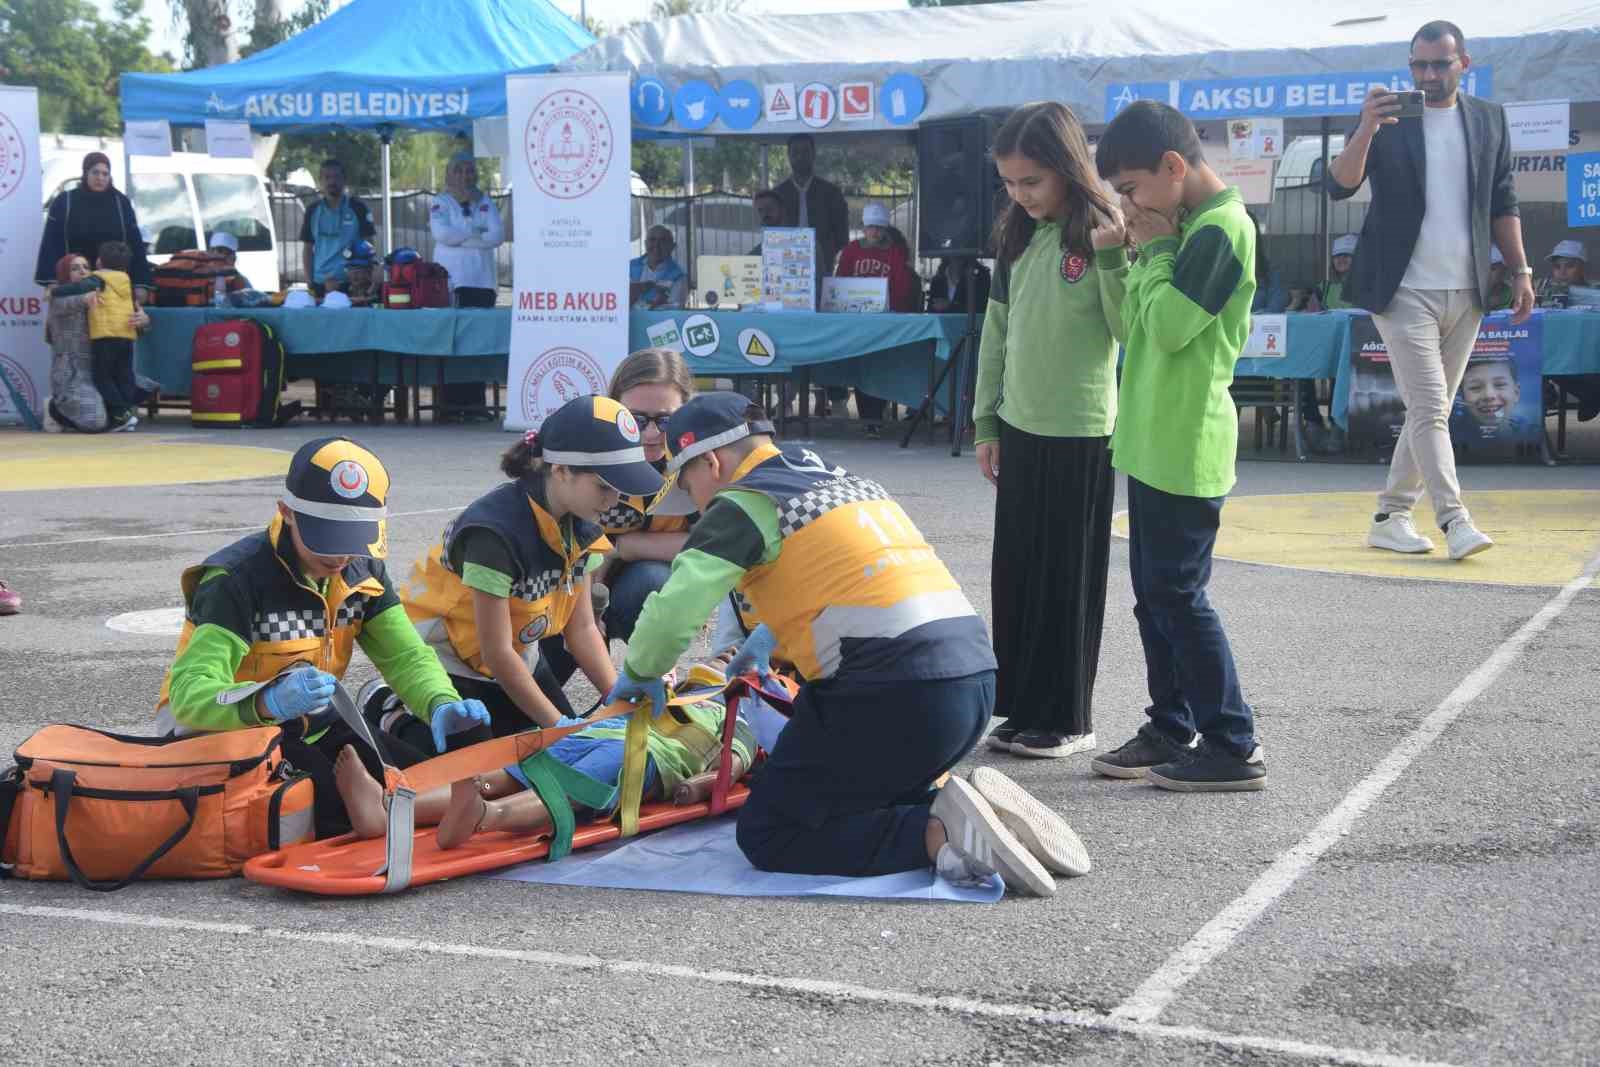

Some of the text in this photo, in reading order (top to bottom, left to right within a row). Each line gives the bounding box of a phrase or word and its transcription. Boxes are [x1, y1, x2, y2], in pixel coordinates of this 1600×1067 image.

[244, 87, 469, 118] AKSU BELEDİYESİ
[1190, 72, 1476, 112] AKSU BELEİİ
[519, 292, 617, 311] MEB AKUB
